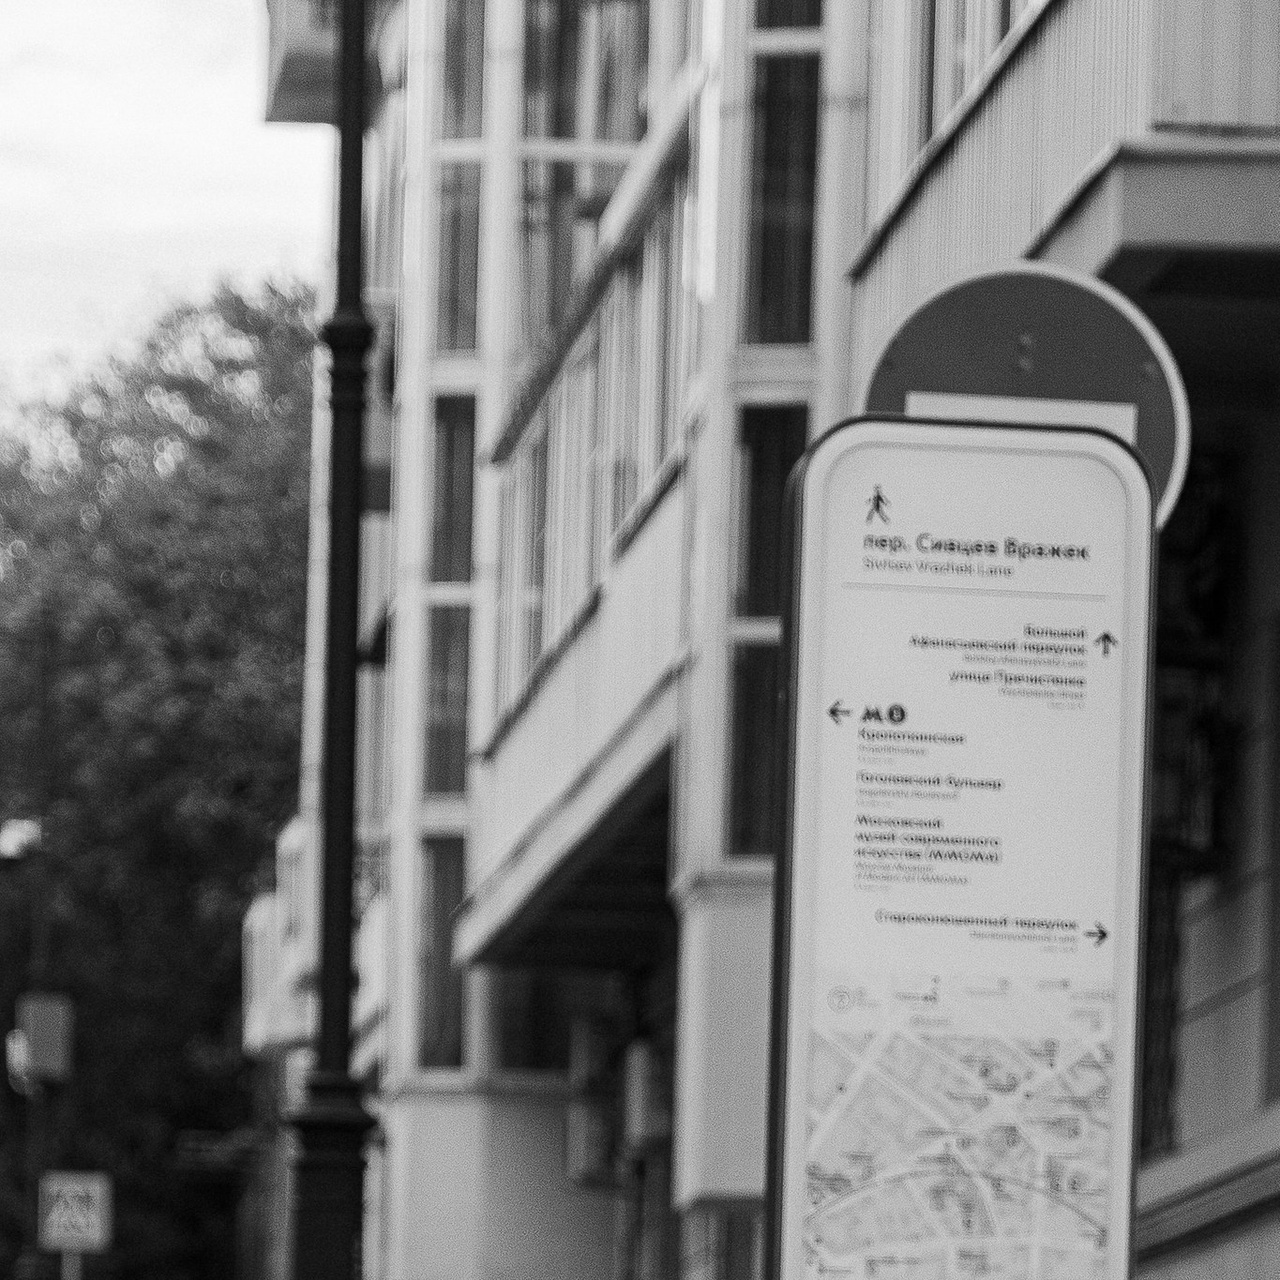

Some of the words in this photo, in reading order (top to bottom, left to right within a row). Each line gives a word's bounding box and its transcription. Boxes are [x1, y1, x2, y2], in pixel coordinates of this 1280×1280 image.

[864, 535, 907, 553] пер.
[917, 534, 996, 556] Сивцев
[1004, 538, 1088, 560] Вражек
